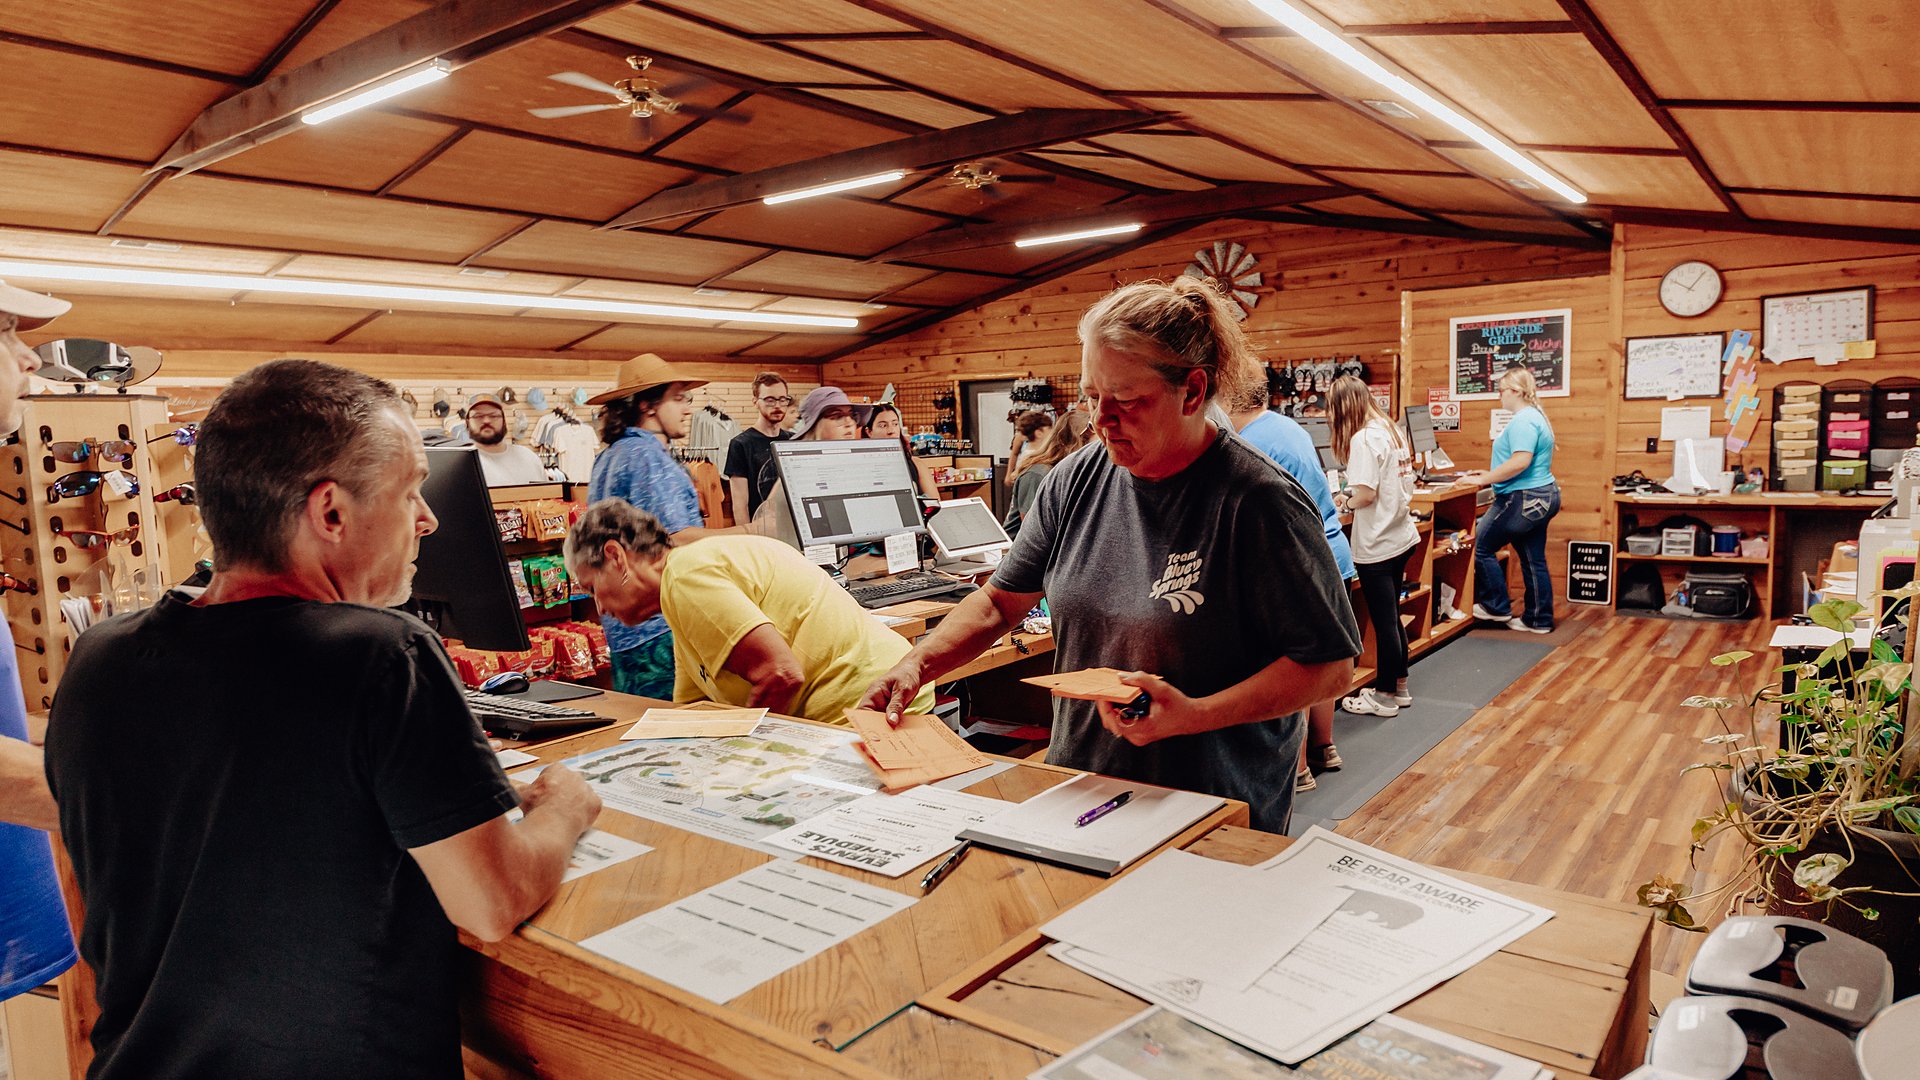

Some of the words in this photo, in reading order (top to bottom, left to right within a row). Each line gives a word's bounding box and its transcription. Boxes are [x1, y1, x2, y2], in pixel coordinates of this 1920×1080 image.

[1481, 323, 1544, 337] RIVERSIDE
[1488, 334, 1524, 346] GRILL
[1167, 550, 1197, 565] Team
[1577, 547, 1603, 555] PARKING
[1149, 571, 1201, 600] Springs
[798, 830, 905, 859] SCHEDULE
[808, 844, 892, 868] EVENTS
[1336, 855, 1364, 869] BE
[1361, 864, 1410, 887] BEAR
[1408, 882, 1485, 910] AWARE
[1357, 1034, 1428, 1067] eler
